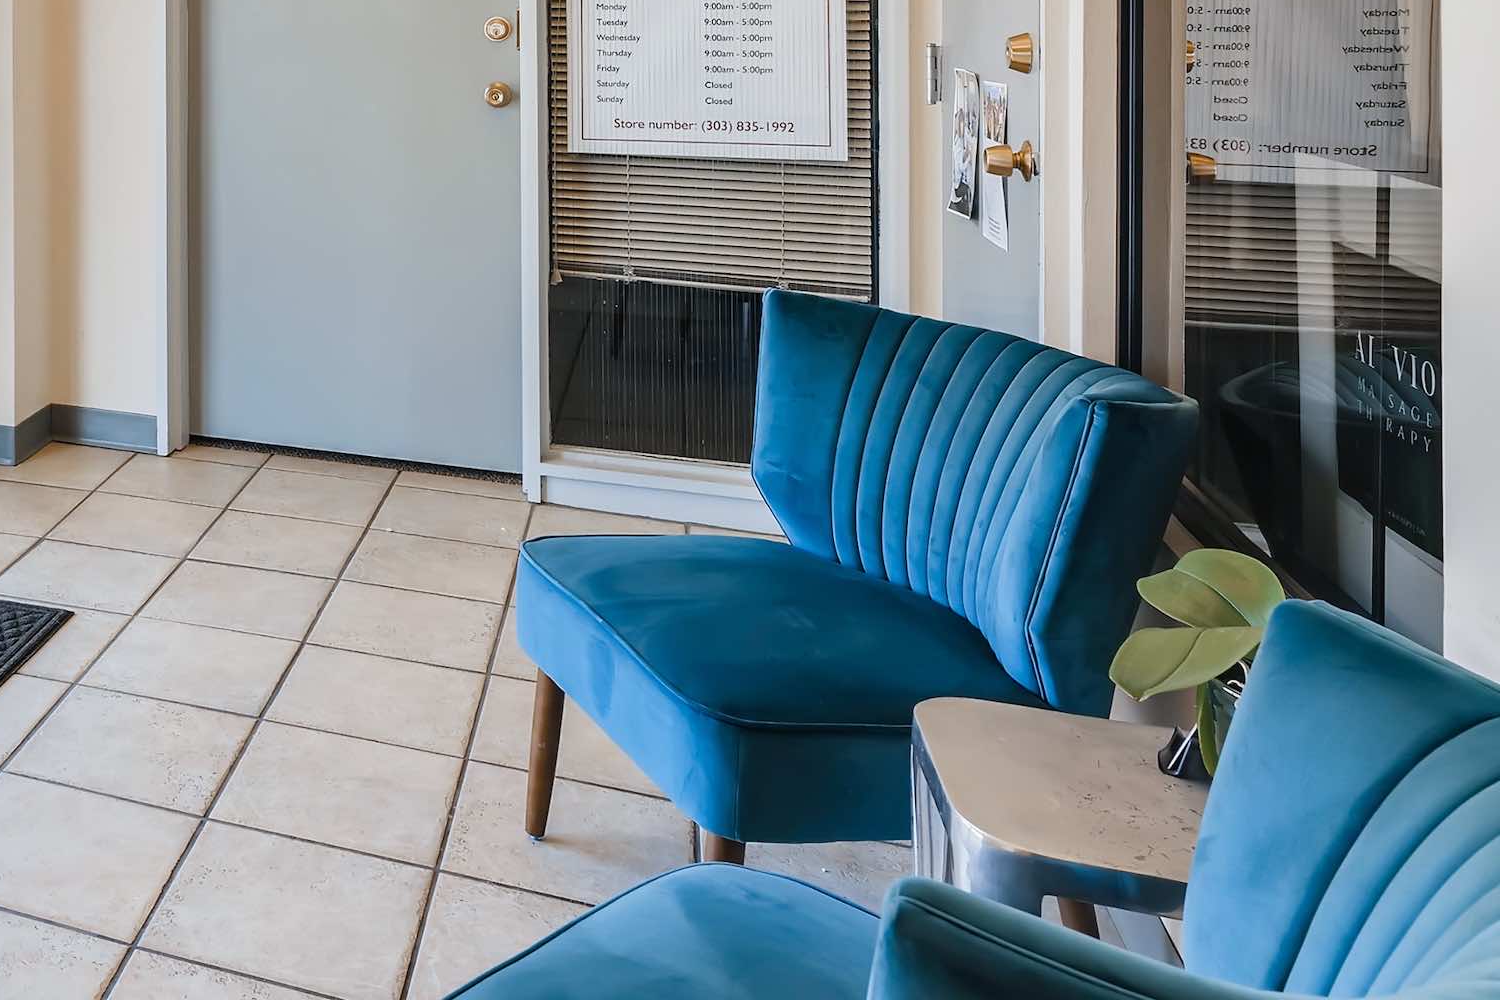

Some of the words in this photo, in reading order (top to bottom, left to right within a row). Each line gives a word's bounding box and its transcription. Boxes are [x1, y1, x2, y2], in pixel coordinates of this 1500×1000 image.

[596, 3, 627, 12] Monday
[742, 2, 772, 11] 5:00pm
[596, 18, 628, 27] Tuesday
[742, 18, 773, 27] 5:00pm
[596, 34, 641, 43] Wednesday
[742, 34, 773, 44] 5:00pm
[597, 49, 633, 58] Thursday
[742, 50, 773, 59] 5:00pm
[597, 64, 620, 73] Friday
[742, 66, 774, 75] 5:00pm
[596, 80, 630, 89] Saturday
[704, 81, 733, 90] Closed
[596, 95, 624, 104] Sunday
[704, 97, 733, 106] Closed
[614, 117, 645, 129] Store
[648, 119, 697, 131] number:
[701, 120, 733, 135] (303)
[736, 121, 795, 133] 835-1992
